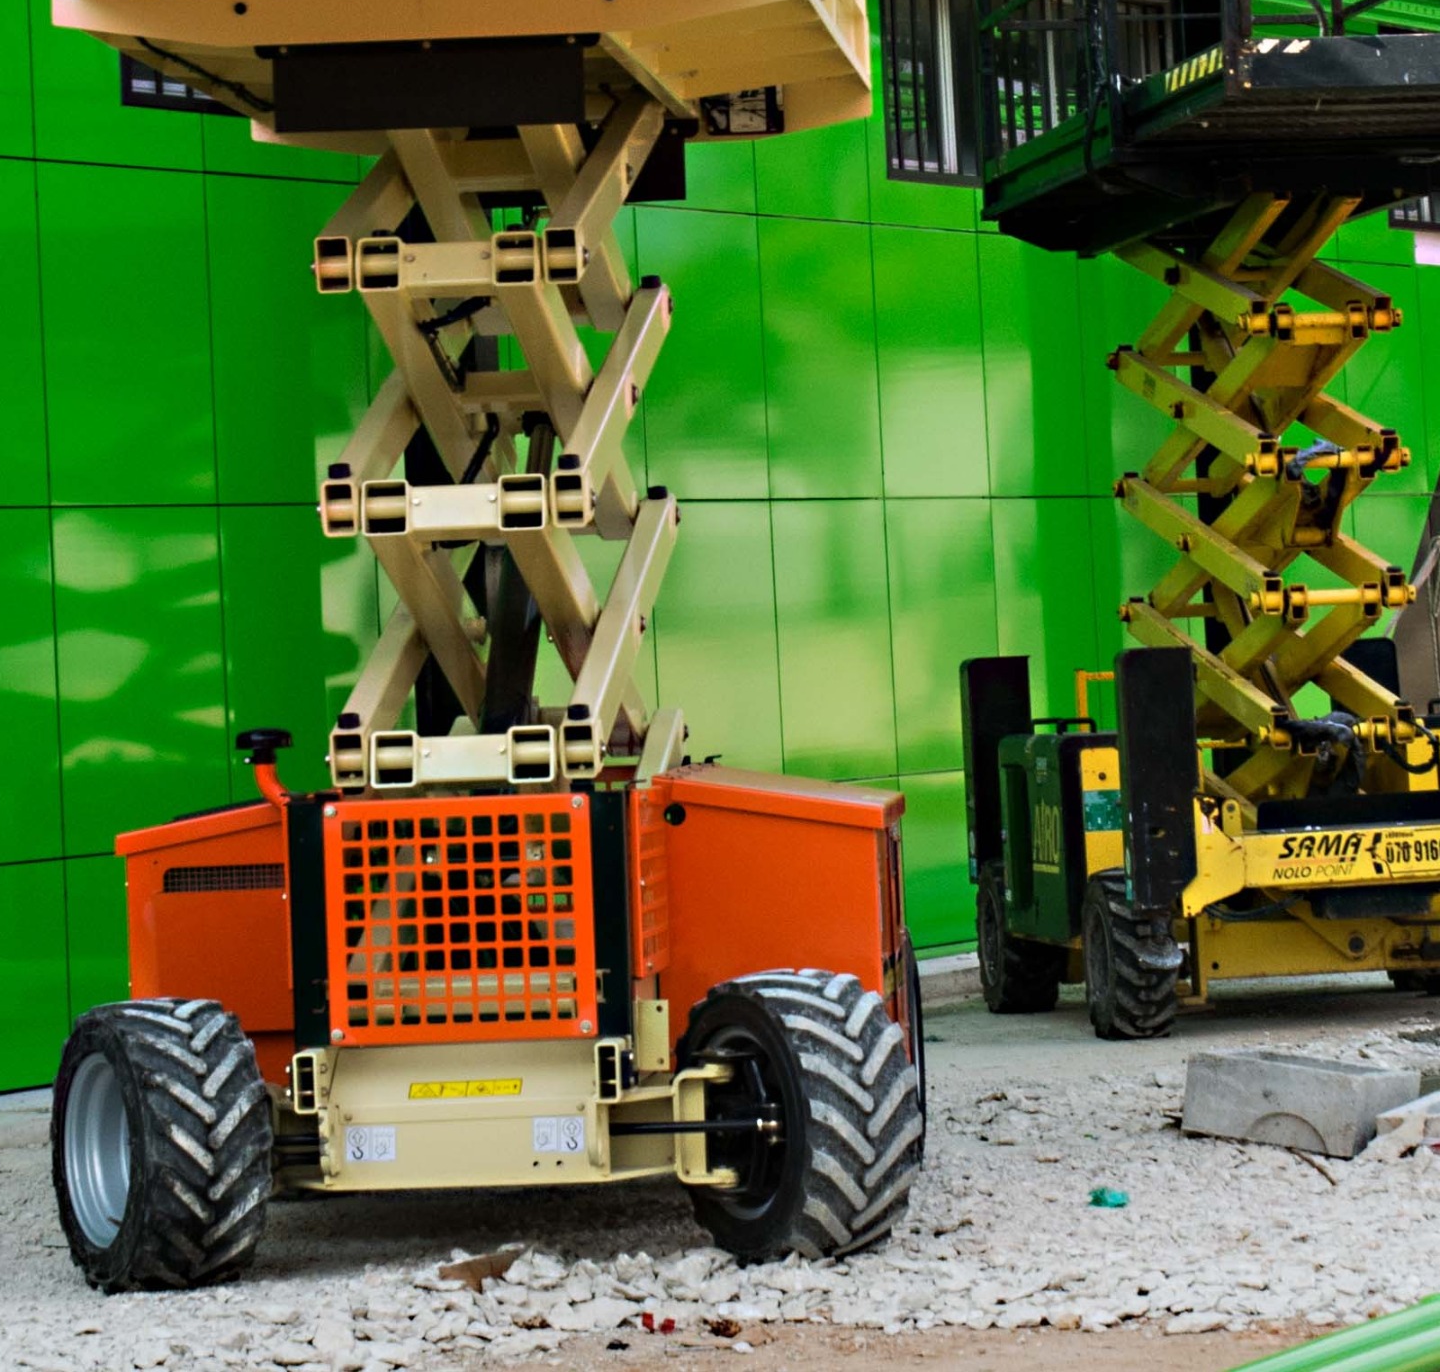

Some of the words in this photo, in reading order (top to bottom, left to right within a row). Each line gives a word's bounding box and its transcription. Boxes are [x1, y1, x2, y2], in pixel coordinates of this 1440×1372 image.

[1278, 833, 1362, 860] SAMA
[1273, 866, 1312, 879] NOLO
[1315, 864, 1354, 877] POINT
